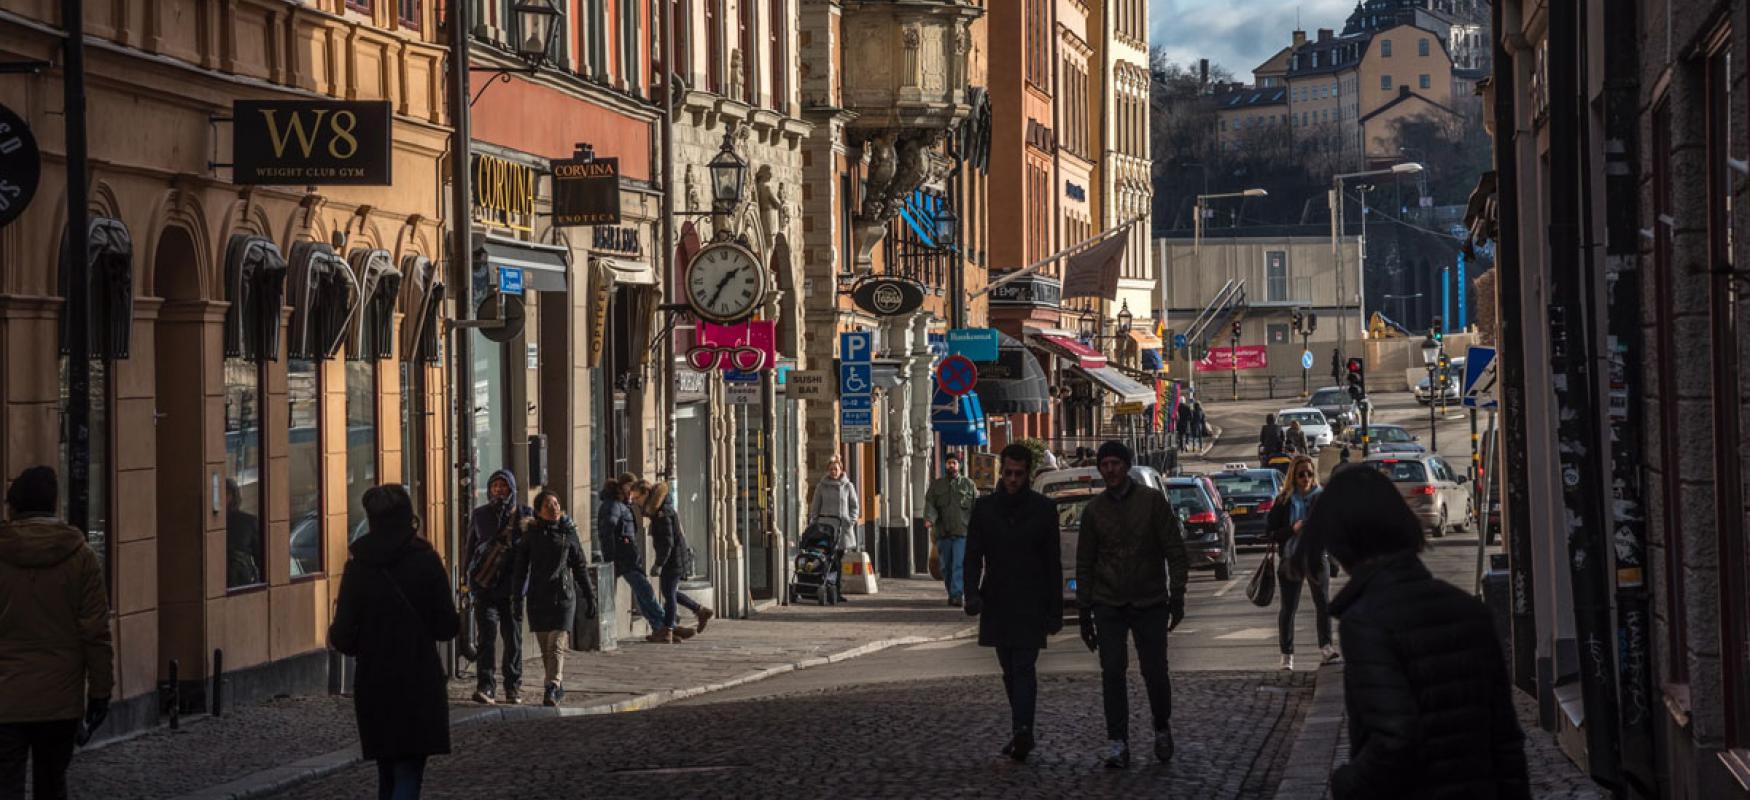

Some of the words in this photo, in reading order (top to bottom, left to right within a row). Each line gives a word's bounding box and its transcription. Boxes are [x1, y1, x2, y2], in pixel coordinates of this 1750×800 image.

[257, 109, 358, 160] W8
[256, 167, 302, 177] WEIGHT
[306, 167, 336, 177] CLUB
[339, 167, 364, 177] GYM
[555, 163, 615, 177] CORVINA
[478, 153, 534, 226] CORVINA
[557, 213, 615, 223] ENOTECA
[848, 336, 866, 360] P
[793, 375, 822, 384] SUSHI
[798, 386, 819, 394] BAR
